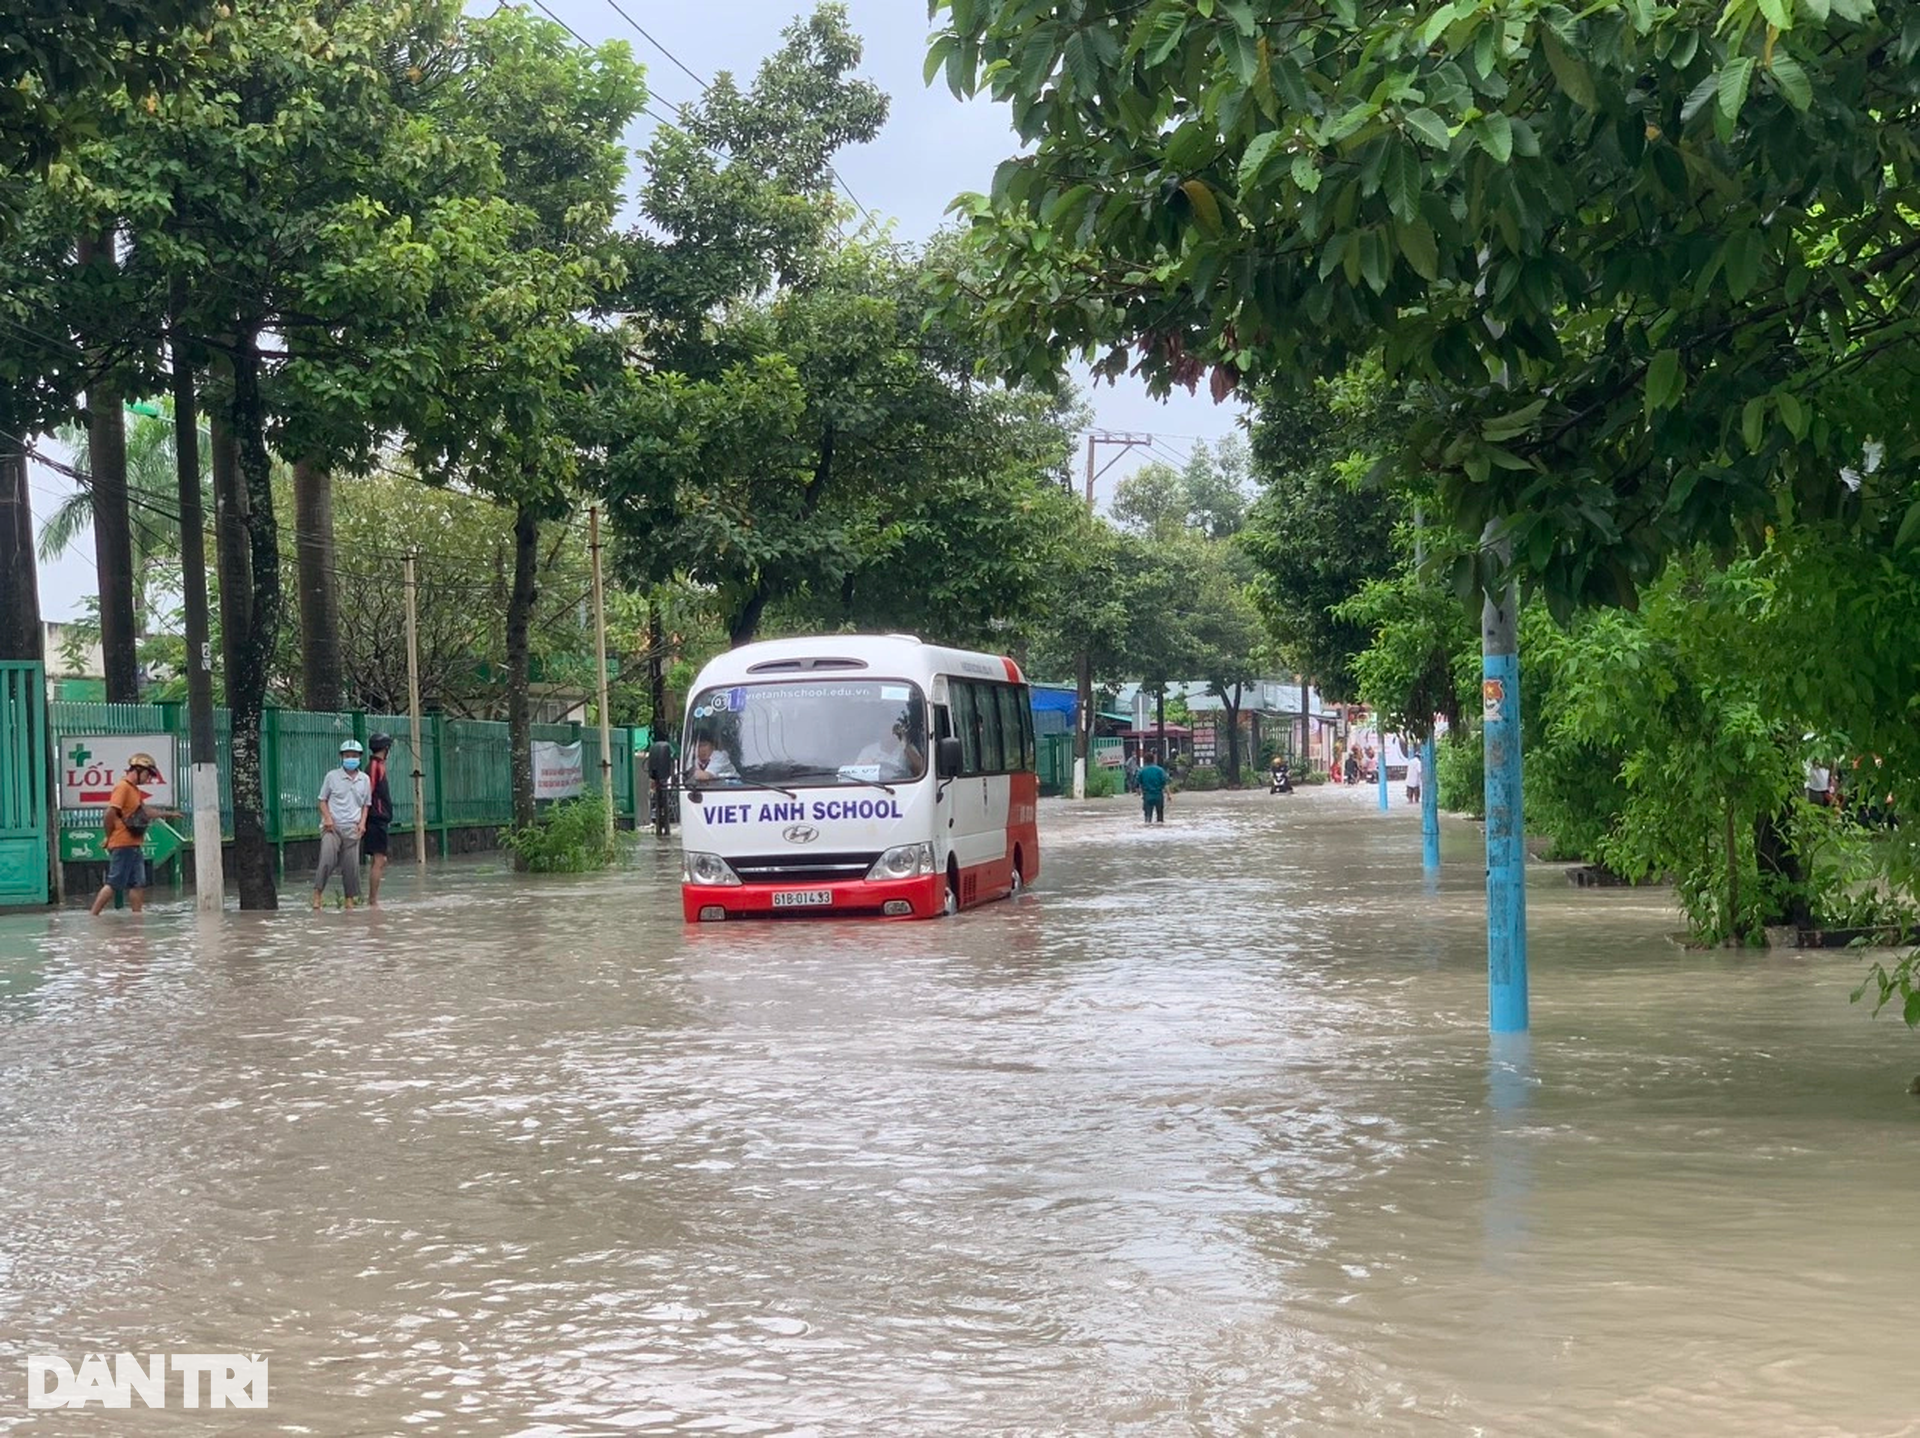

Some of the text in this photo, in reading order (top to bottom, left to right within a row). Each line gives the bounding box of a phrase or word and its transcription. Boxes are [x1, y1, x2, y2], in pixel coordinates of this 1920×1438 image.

[66, 761, 114, 787] LỐI
[703, 800, 904, 824] VIET ANH SCHOOL
